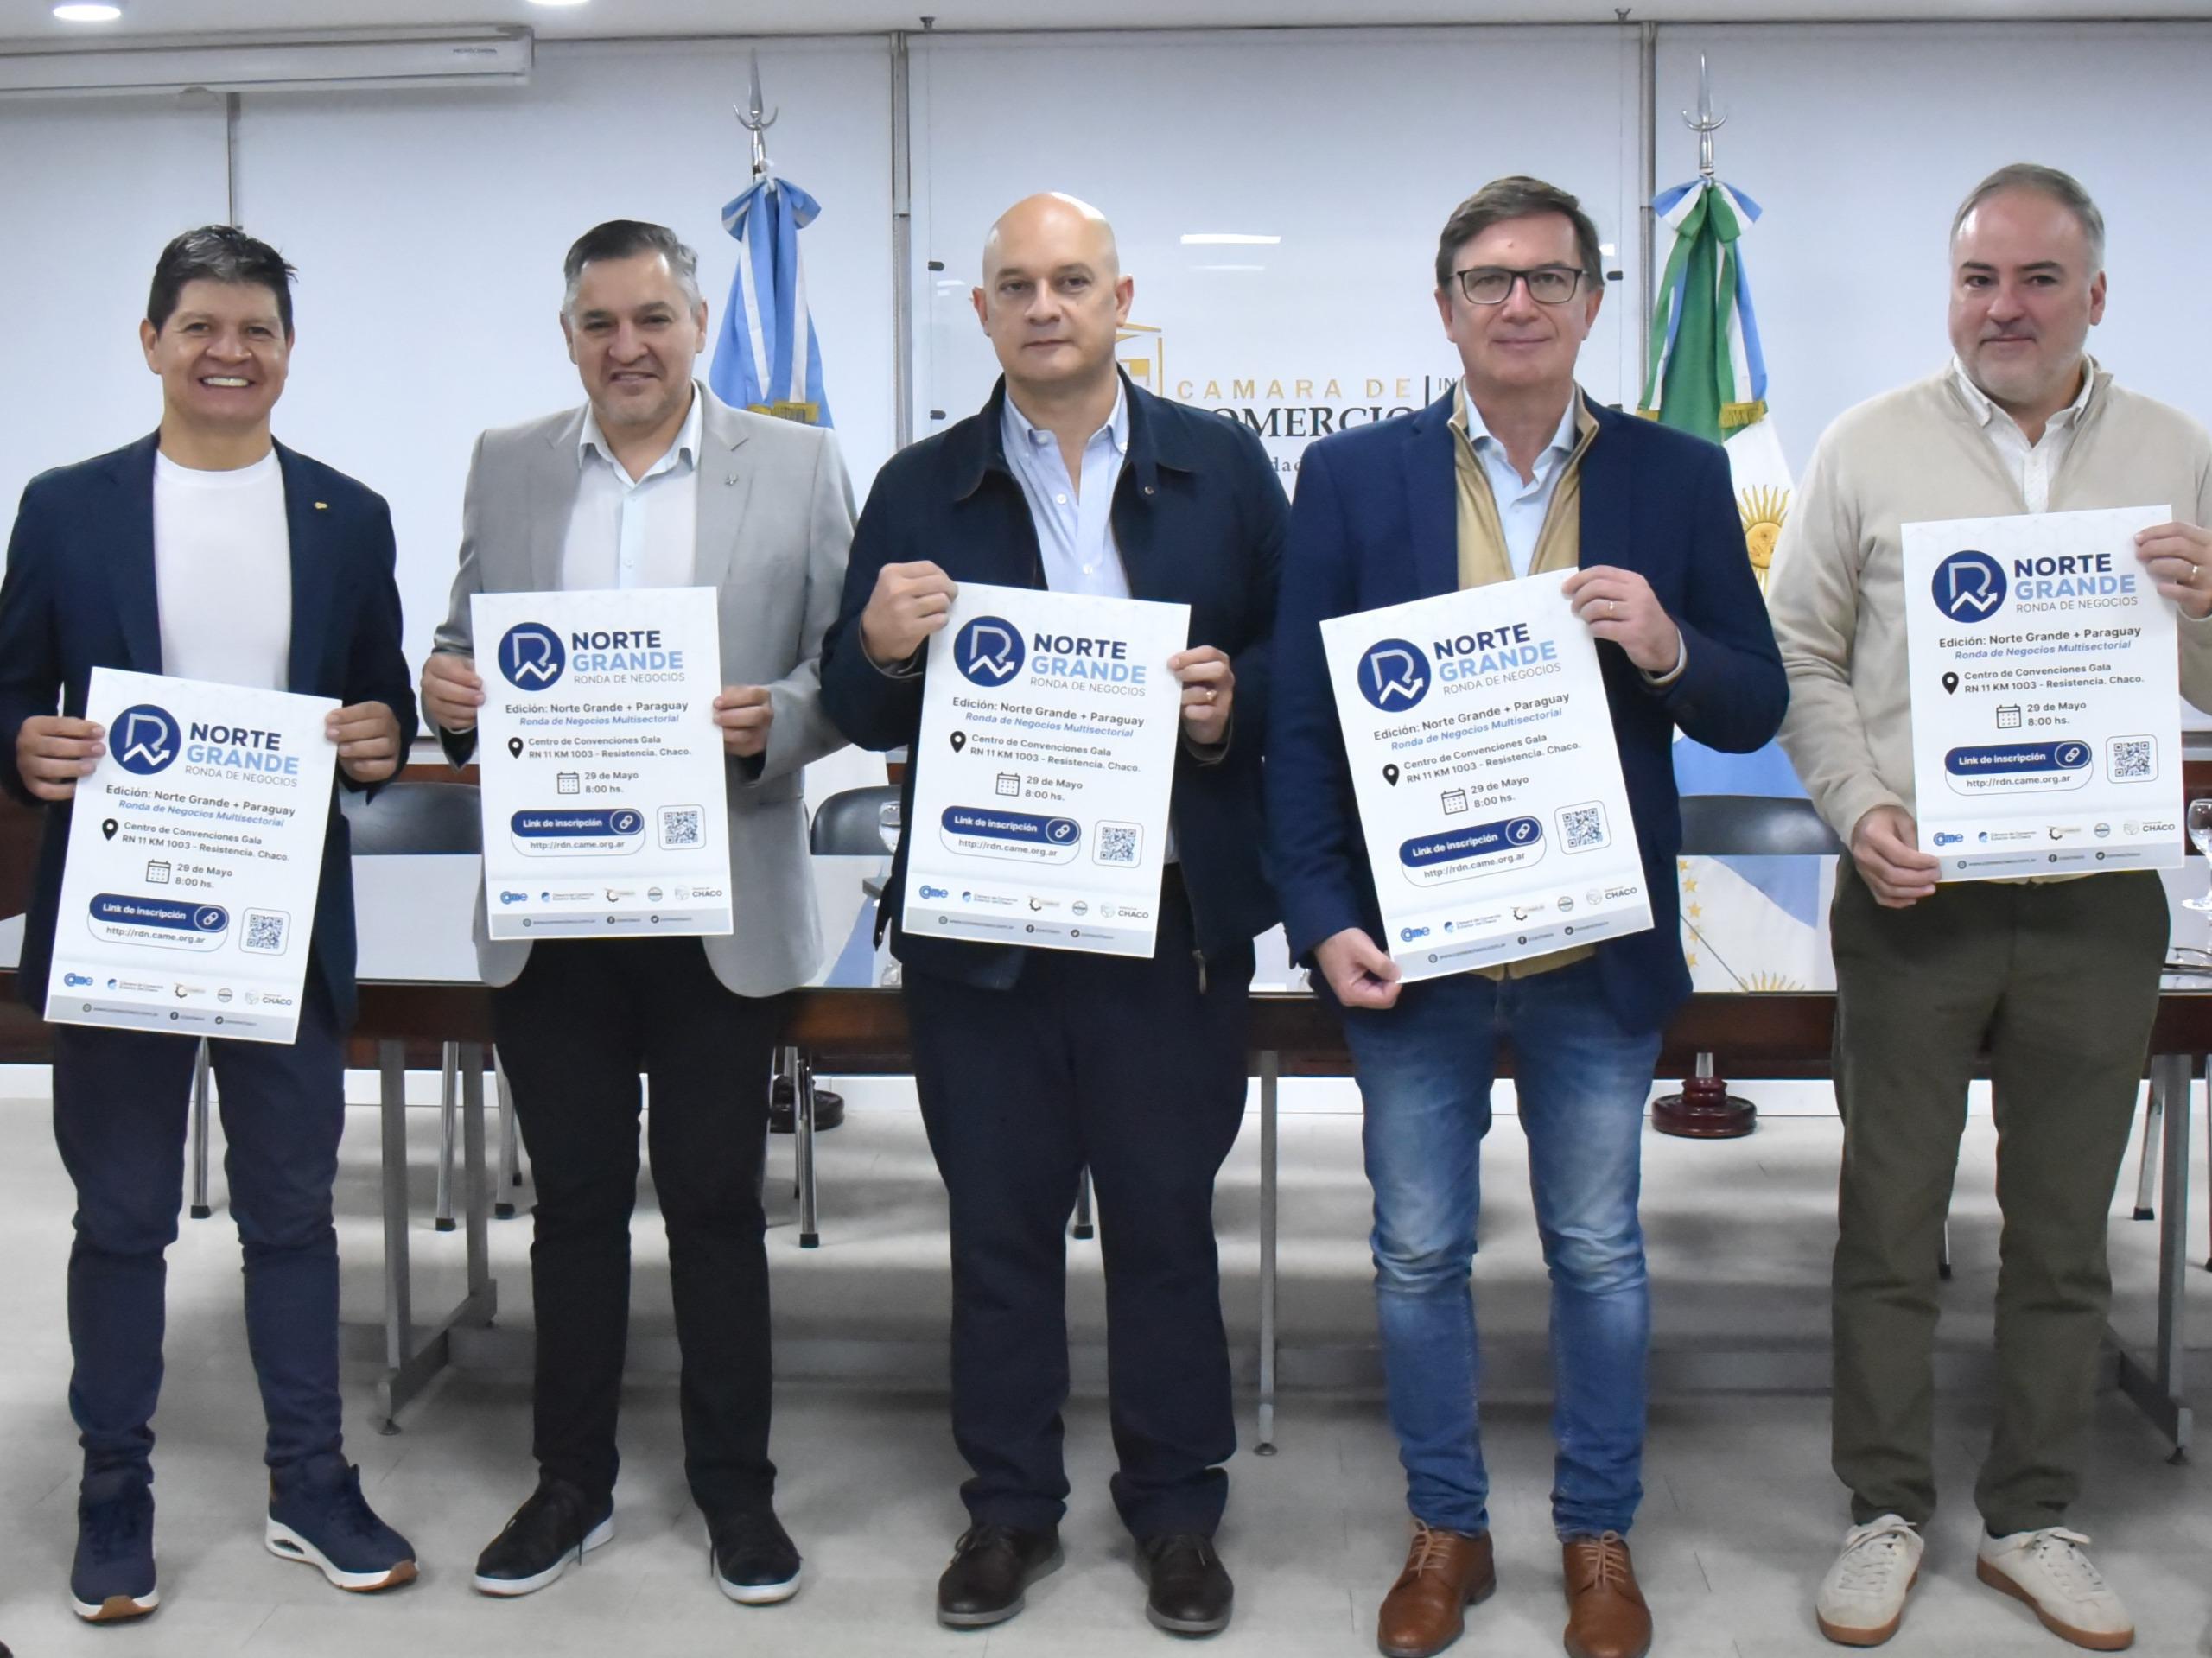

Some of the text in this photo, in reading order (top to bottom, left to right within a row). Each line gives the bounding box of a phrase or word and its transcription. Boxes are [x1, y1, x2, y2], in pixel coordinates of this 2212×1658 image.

[1177, 379, 1411, 400] CAMARA DE
[2014, 553, 2112, 578] NORTE
[2014, 573, 2136, 600] GRANDE
[2016, 595, 2138, 613] RONDA DE NEGOCIOS
[571, 630, 661, 651] NORTE
[1033, 632, 1127, 660] NORTE
[1433, 622, 1530, 660] NORTE
[1939, 627, 2141, 648] Edición: Norte Grande Paraguay
[1955, 639, 2131, 659] Ronda de Negocios Multisectorial
[572, 651, 683, 672] GRANDE
[1031, 655, 1146, 684] GRANDE
[1439, 640, 1557, 682] GRANDE
[574, 672, 684, 684] RONDA DE NEGOCIOS
[1443, 662, 1561, 695] RONDA DE NEGOCIOS
[1964, 671, 1998, 680] Centro
[2015, 665, 2086, 677] Convenciones
[2088, 663, 2111, 671] Gala
[1030, 677, 1145, 696] RONDA DE NEGOCIOS
[1993, 683, 2009, 691] KM
[2012, 681, 2037, 689] 1003
[505, 702, 688, 714] Edición: Norte Grande Paraguay
[952, 696, 1144, 727] Edición: Norte Grande Paraguay
[2027, 702, 2086, 712] 29 de Mayo
[1373, 693, 1569, 740] Edición: Norte Grande Paraguay
[2027, 716, 2052, 726] 8:00
[189, 722, 281, 751] NORTE
[1391, 708, 1561, 750] Ronda de Negocios Multisectorial
[970, 746, 983, 755] RN
[987, 748, 995, 757] 11
[997, 750, 1013, 759] KM
[1015, 752, 1039, 762] 1003
[971, 734, 1111, 756] Centro de Convenciones Gala
[1403, 758, 1437, 769] Centro
[1453, 740, 1522, 759] Convenciones
[1524, 734, 1547, 745] Gala
[187, 744, 299, 775] GRANDE
[1958, 756, 1978, 765] Link
[1993, 752, 2046, 763] inscripción
[185, 765, 297, 787] RONDA DE NEGOCIOS
[584, 772, 597, 780] 29
[613, 772, 639, 780] Mayo
[1406, 773, 1421, 783] RN
[1422, 771, 1432, 779] 11
[1433, 767, 1450, 777] KM
[1452, 761, 1477, 773] 1003
[585, 785, 607, 793] 8:00
[1026, 775, 1083, 790] 29 de Mayo
[1471, 777, 1529, 794] 29 de Mayo
[1966, 775, 2070, 788] http://rdn.came.org.ar
[105, 784, 295, 817] Edición: Norte Grande Paraguay
[1025, 789, 1048, 799] 8:00
[1473, 796, 1497, 808] 8:00
[124, 821, 156, 832] Centro
[172, 827, 238, 842] Convenciones
[241, 835, 262, 844] Gala
[954, 816, 1037, 832] Link de inscripción
[2142, 823, 2175, 832] CHACO
[122, 834, 136, 842] RN
[167, 839, 190, 849] 1003
[530, 842, 625, 850] http://rdn.came.org.ar
[958, 839, 1057, 857] http://rdn.came.org.ar
[1412, 834, 1498, 857] Link de inscripción
[176, 863, 189, 872] 29
[206, 867, 232, 878] Mayo
[1423, 853, 1525, 878] http://rdn.came.org.ar
[175, 876, 198, 886] 8:00
[1605, 886, 1637, 899] CHACO
[102, 903, 186, 919] Link de inscripción
[1117, 910, 1148, 918] CHACO
[105, 926, 205, 944] http://rdn.came.org.ar
[262, 995, 292, 1006] CHACO
